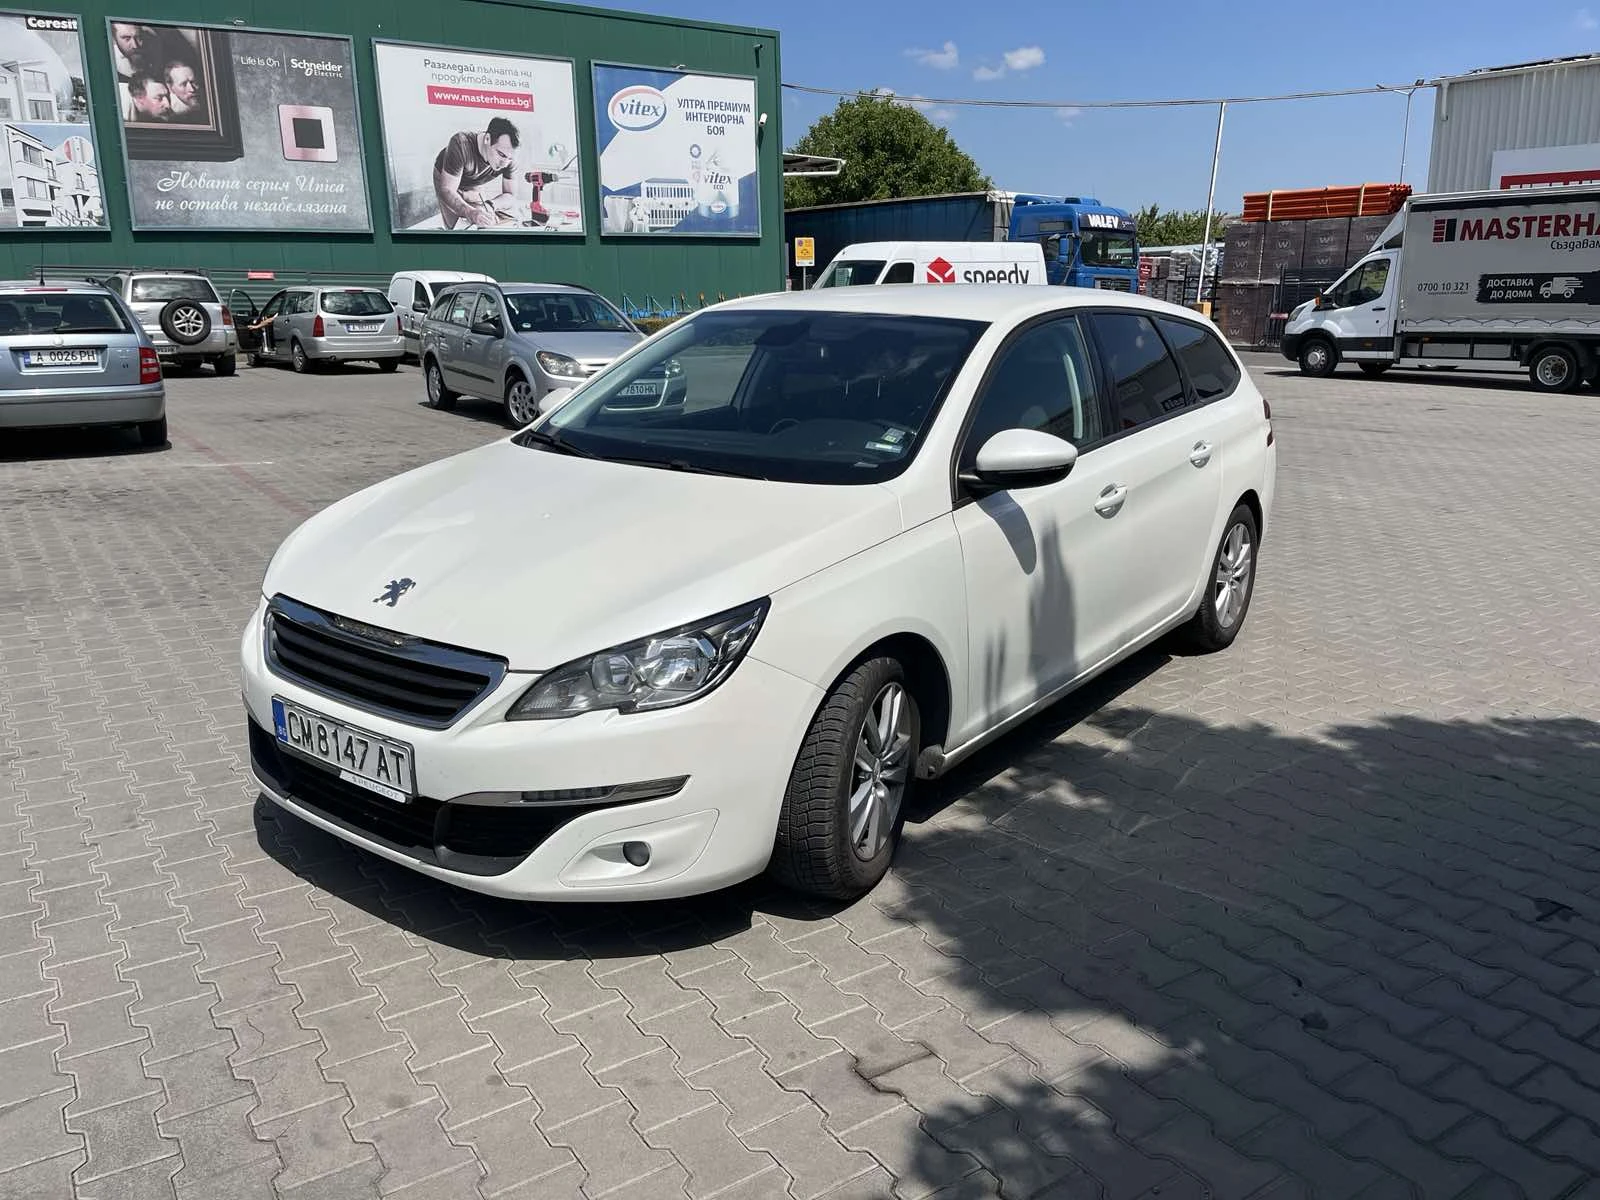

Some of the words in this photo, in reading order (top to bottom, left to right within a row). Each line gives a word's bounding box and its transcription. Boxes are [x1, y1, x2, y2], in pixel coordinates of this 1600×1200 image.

[27, 16, 78, 30] Ceresit
[240, 56, 257, 66] Life
[257, 57, 266, 66] Is
[290, 58, 343, 72] Schneider
[423, 58, 475, 73] Разгледай
[476, 65, 519, 76] пълната
[520, 70, 532, 78] ни
[313, 70, 343, 79] Electric
[431, 71, 493, 86] продуктова
[494, 79, 517, 87] гама
[518, 80, 531, 89] на
[433, 90, 530, 109] www.masterhaus.bg
[677, 98, 705, 110] УЛТРА
[706, 99, 751, 113] ПРЕМИУМ
[619, 99, 661, 117] vitex
[685, 111, 745, 126] ИНТЕРИОРНА
[706, 125, 726, 136] БОЯ
[156, 170, 241, 192] Новата
[245, 179, 290, 197] серия
[295, 174, 345, 193] Unica
[704, 171, 732, 185] vitex
[154, 199, 174, 211] не
[179, 191, 239, 211] остава
[243, 196, 347, 214] незабелязана
[1087, 213, 1119, 229] VALEV
[1459, 212, 1600, 242] MASTERH
[963, 262, 1029, 284] speedy
[1417, 282, 1439, 292] 0700
[1441, 282, 1452, 291] 10
[1453, 281, 1469, 291] 321
[1486, 278, 1534, 289] ДОСТАВКА
[1490, 289, 1504, 300] ДО
[1504, 289, 1533, 300] ДОМА
[377, 746, 405, 785] AT
